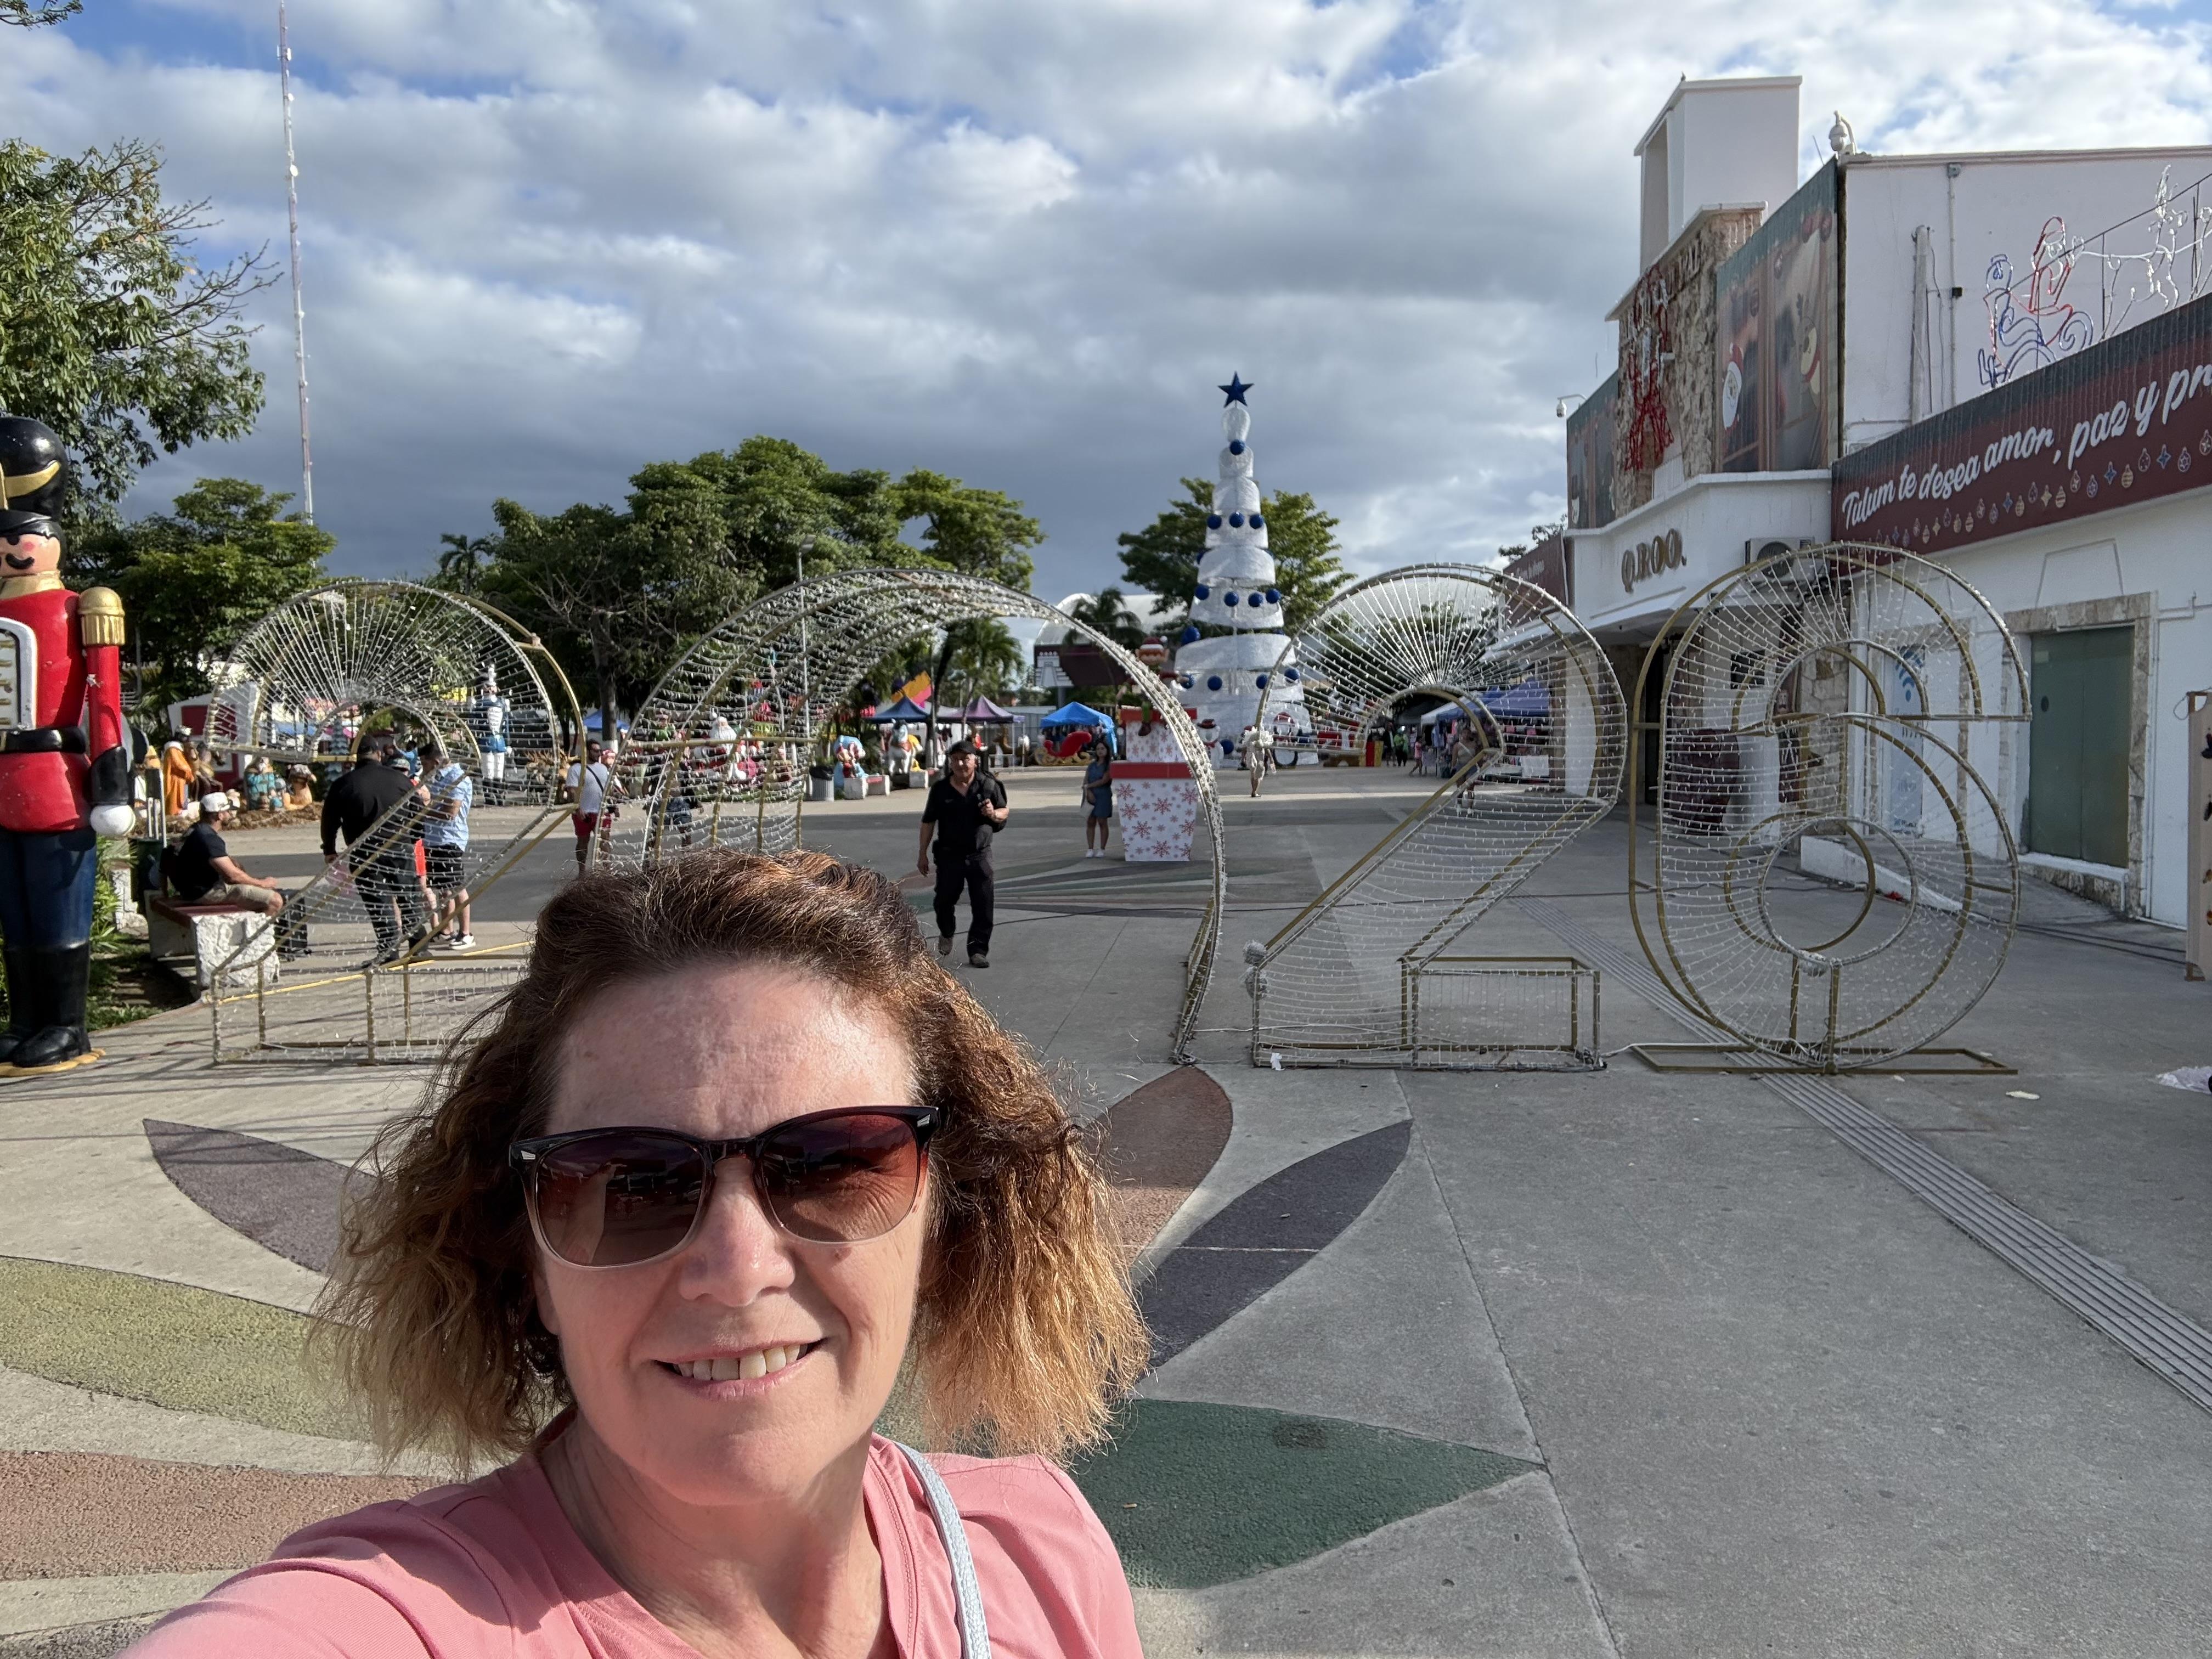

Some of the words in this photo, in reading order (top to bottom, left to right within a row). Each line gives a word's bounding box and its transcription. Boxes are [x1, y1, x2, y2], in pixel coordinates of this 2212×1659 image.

[1842, 479, 1895, 531] Tulum
[1898, 464, 1917, 501] te
[1918, 456, 1981, 500] desea
[1984, 426, 2061, 473] amor,
[2067, 400, 2130, 471] paz
[2135, 381, 2160, 437] y
